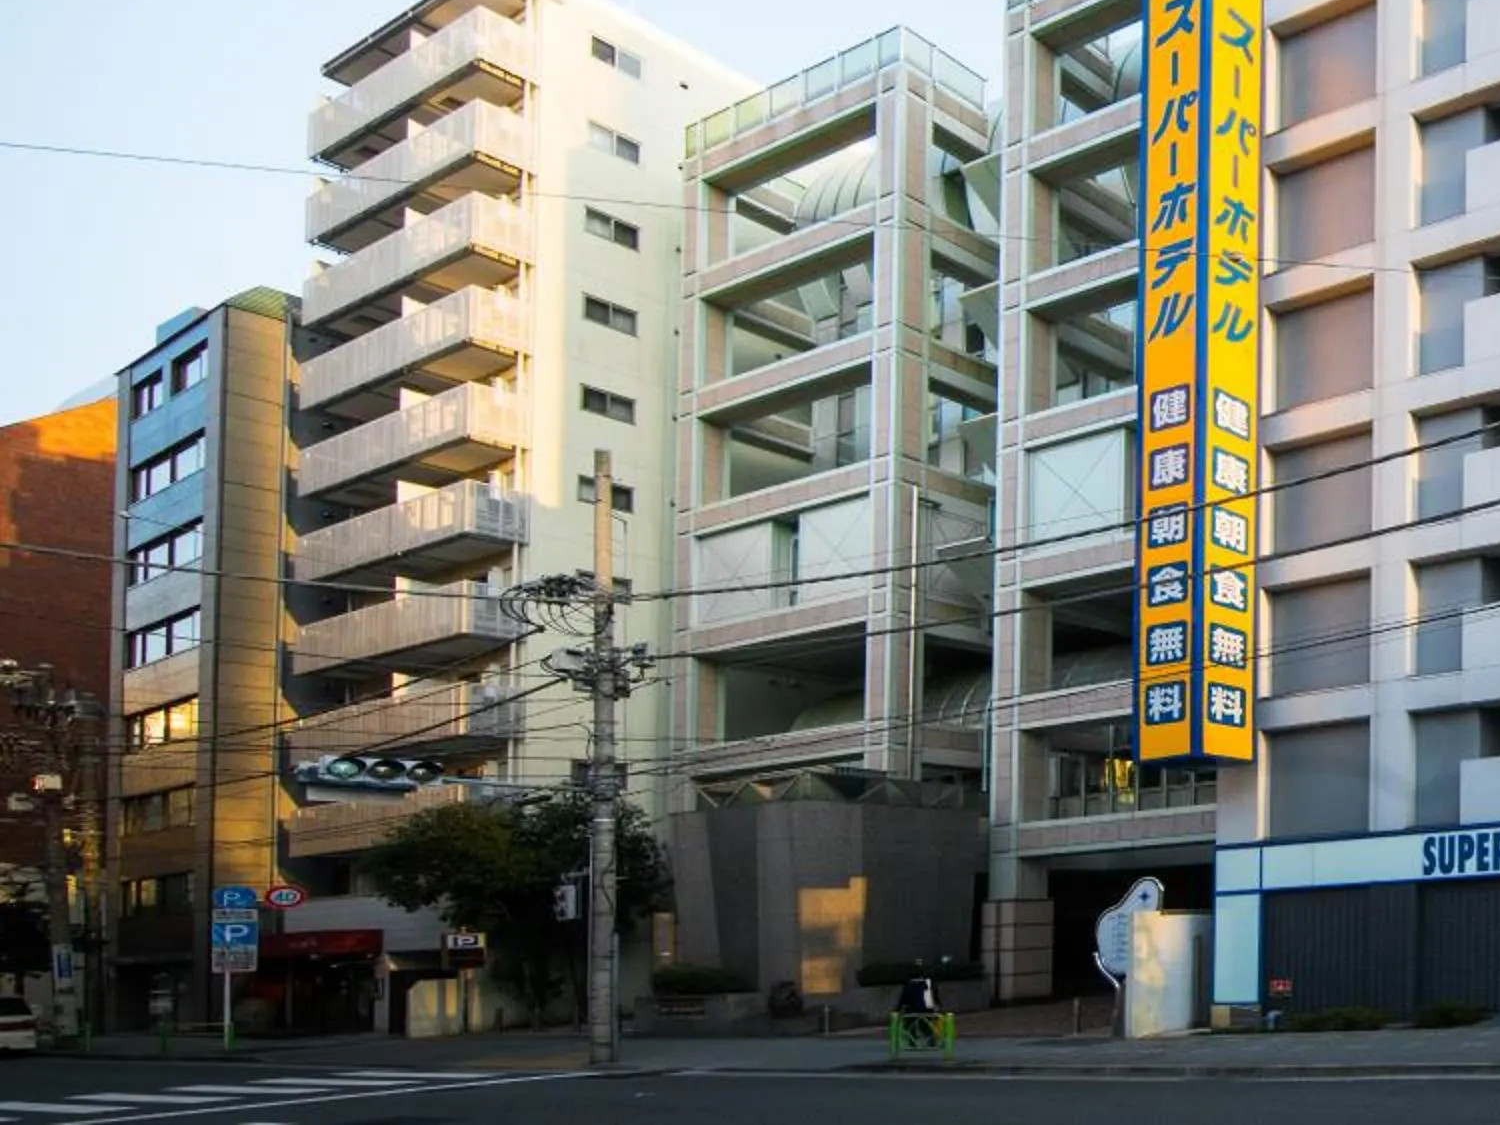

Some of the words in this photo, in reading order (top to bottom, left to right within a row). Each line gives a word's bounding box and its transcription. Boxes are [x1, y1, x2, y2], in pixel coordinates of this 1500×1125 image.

[1211, 7, 1257, 343] スーパーホテル
[1147, 388, 1188, 722] 健康朝食無料
[1209, 392, 1249, 728] 健康朝食無料
[224, 924, 249, 943] P
